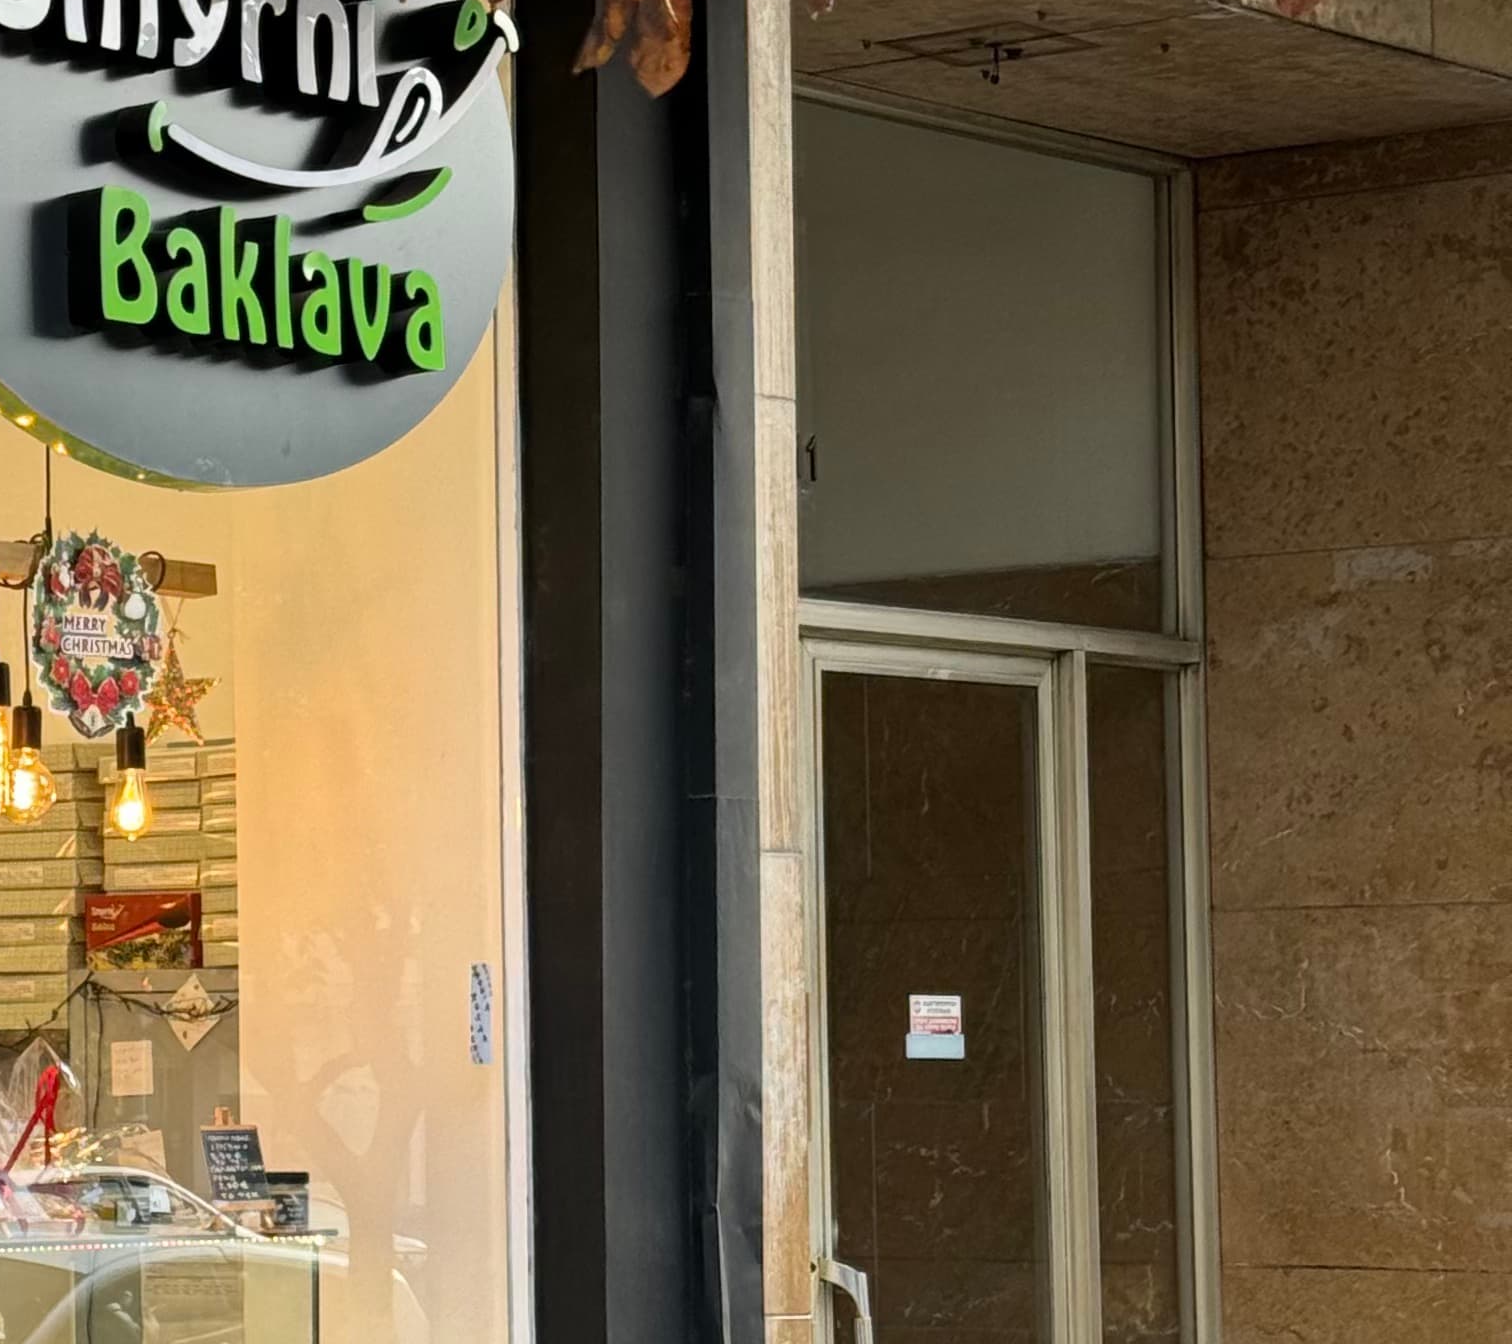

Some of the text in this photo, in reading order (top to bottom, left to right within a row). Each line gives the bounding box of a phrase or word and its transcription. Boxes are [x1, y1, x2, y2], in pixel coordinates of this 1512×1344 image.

[101, 186, 445, 371] Baklava
[64, 615, 106, 632] MERRY
[61, 637, 134, 656] CHRISTMAS
